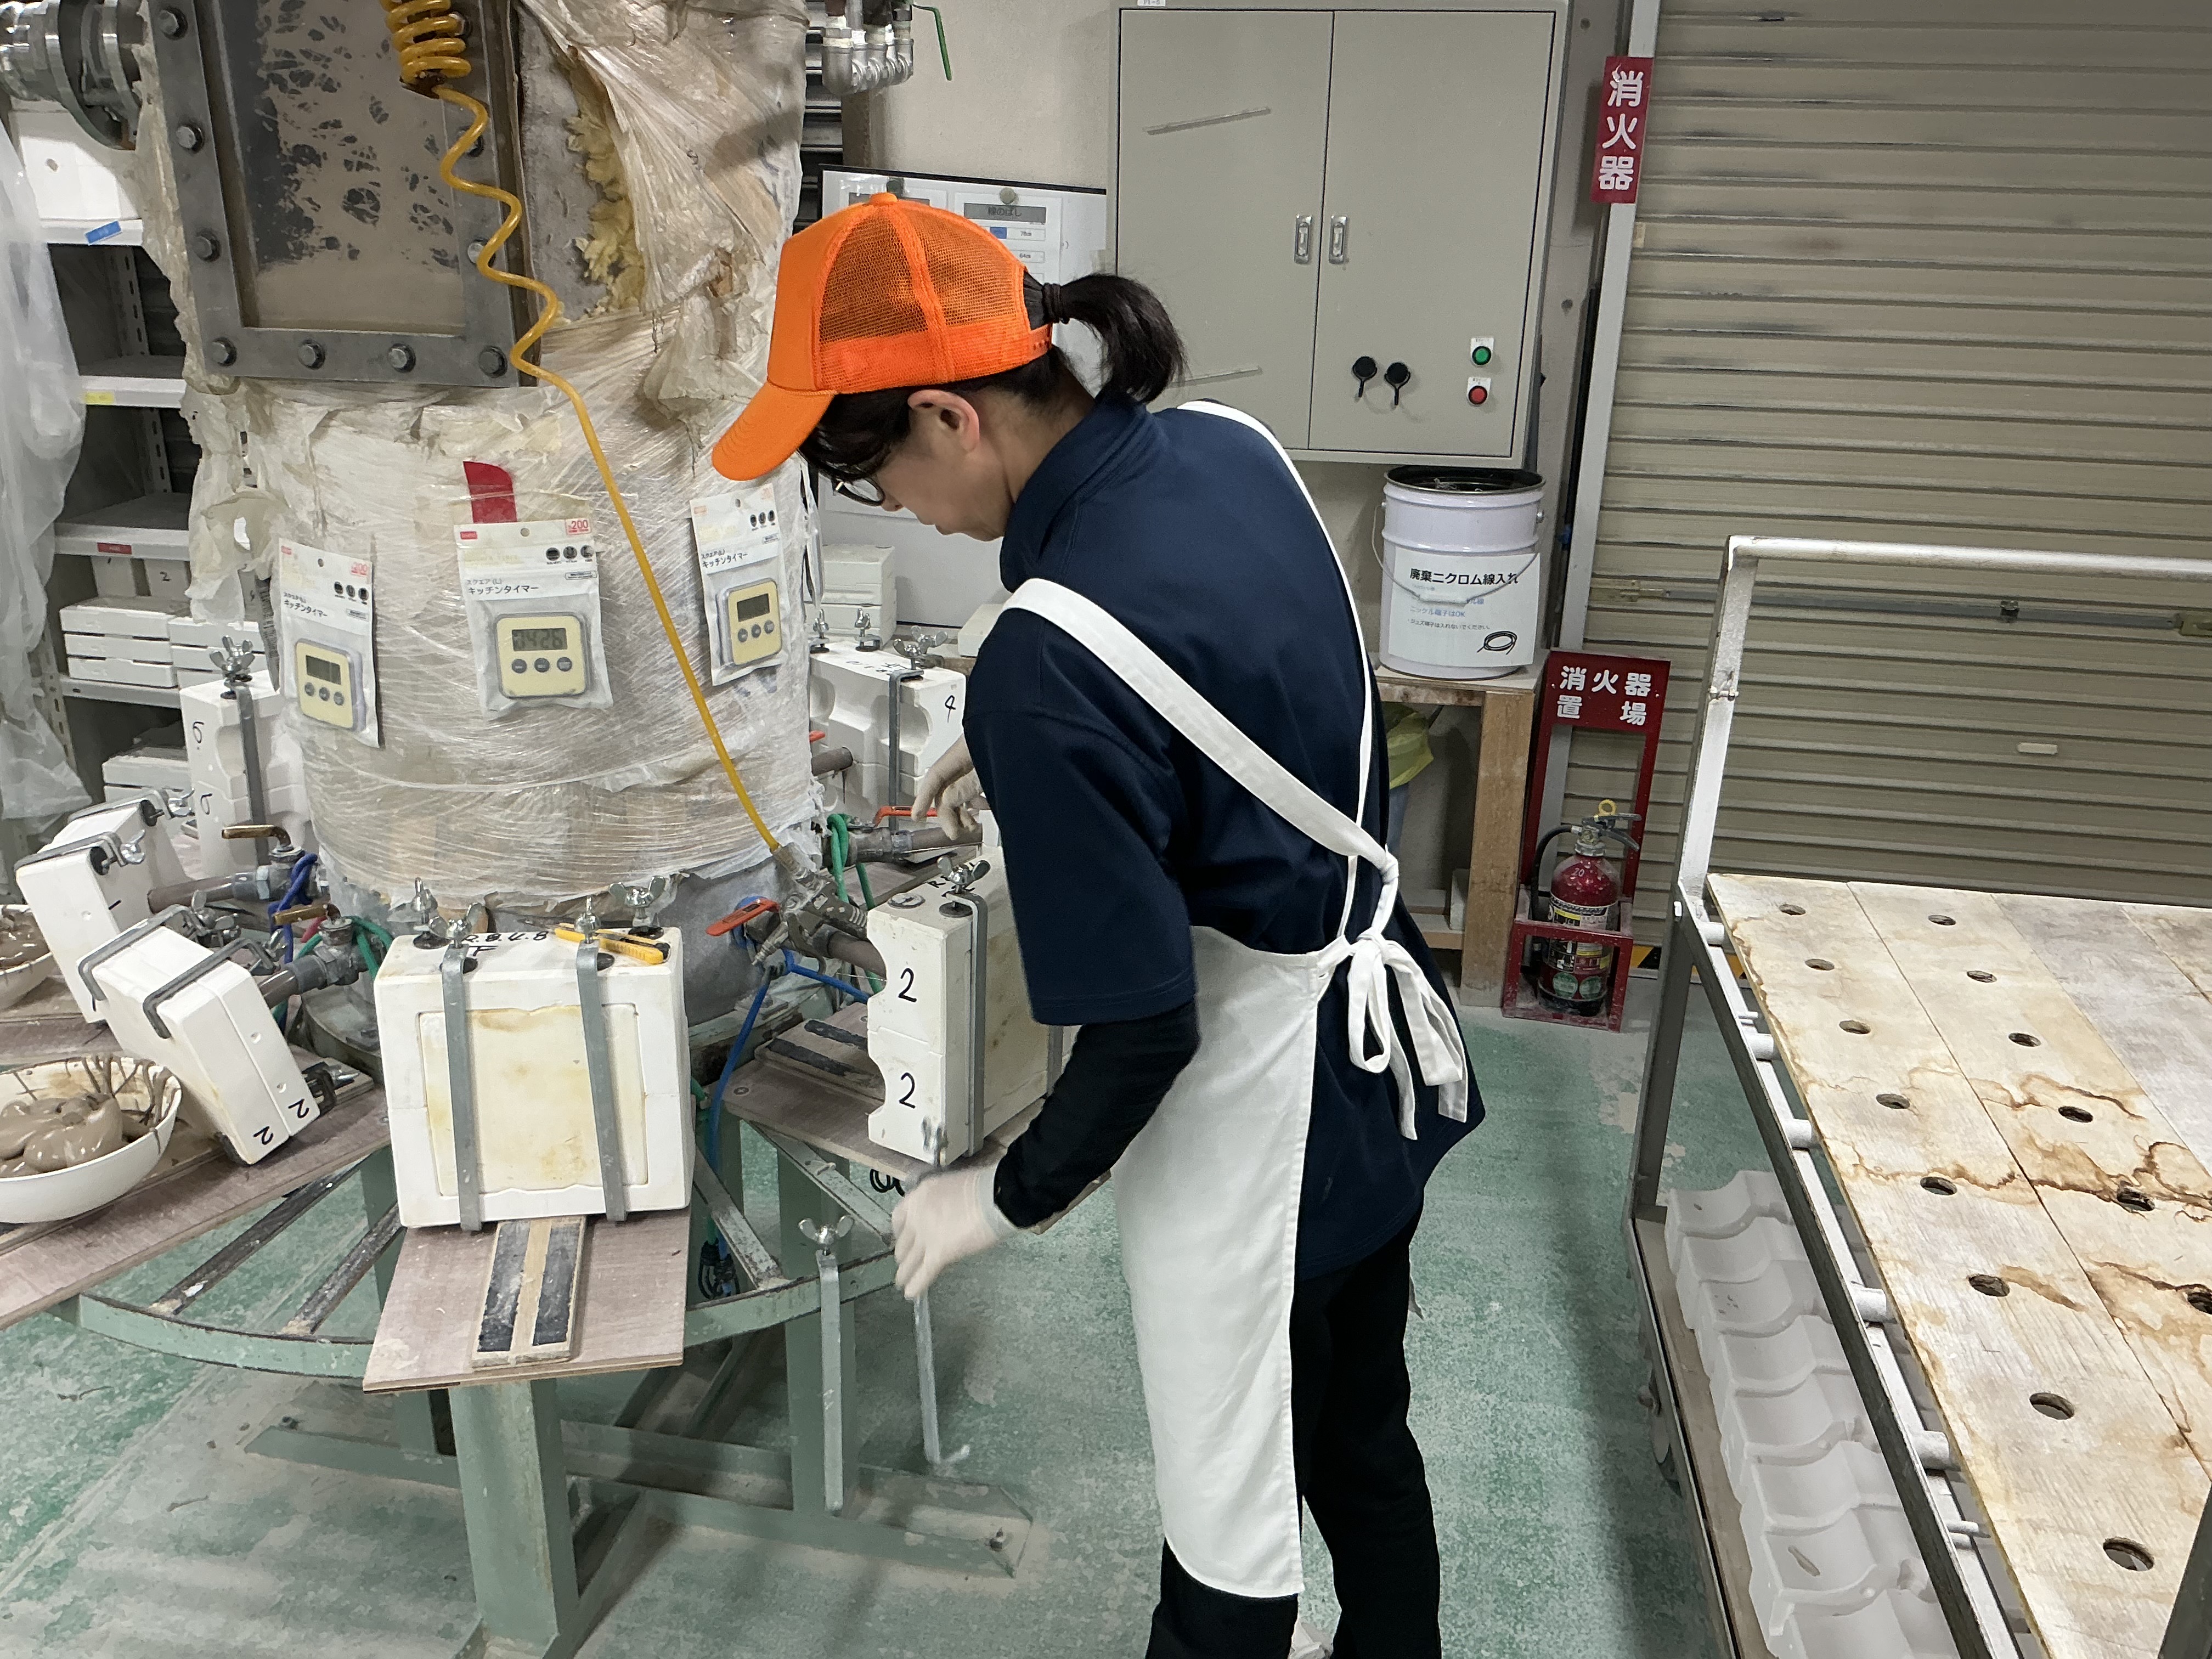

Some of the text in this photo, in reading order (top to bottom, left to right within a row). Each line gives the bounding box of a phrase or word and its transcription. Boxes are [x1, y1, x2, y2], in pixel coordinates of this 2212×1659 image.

[1599, 69, 1644, 190] 消火器
[702, 552, 748, 568] キッチンタイマー
[1409, 568, 1519, 585] 廃棄ニクロム線入れ
[468, 585, 539, 595] キッチンタイマー
[284, 599, 328, 618] キッチンタイマー
[1559, 665, 1651, 697] 消火器
[898, 968, 917, 1002] 2
[899, 1072, 916, 1109] 2
